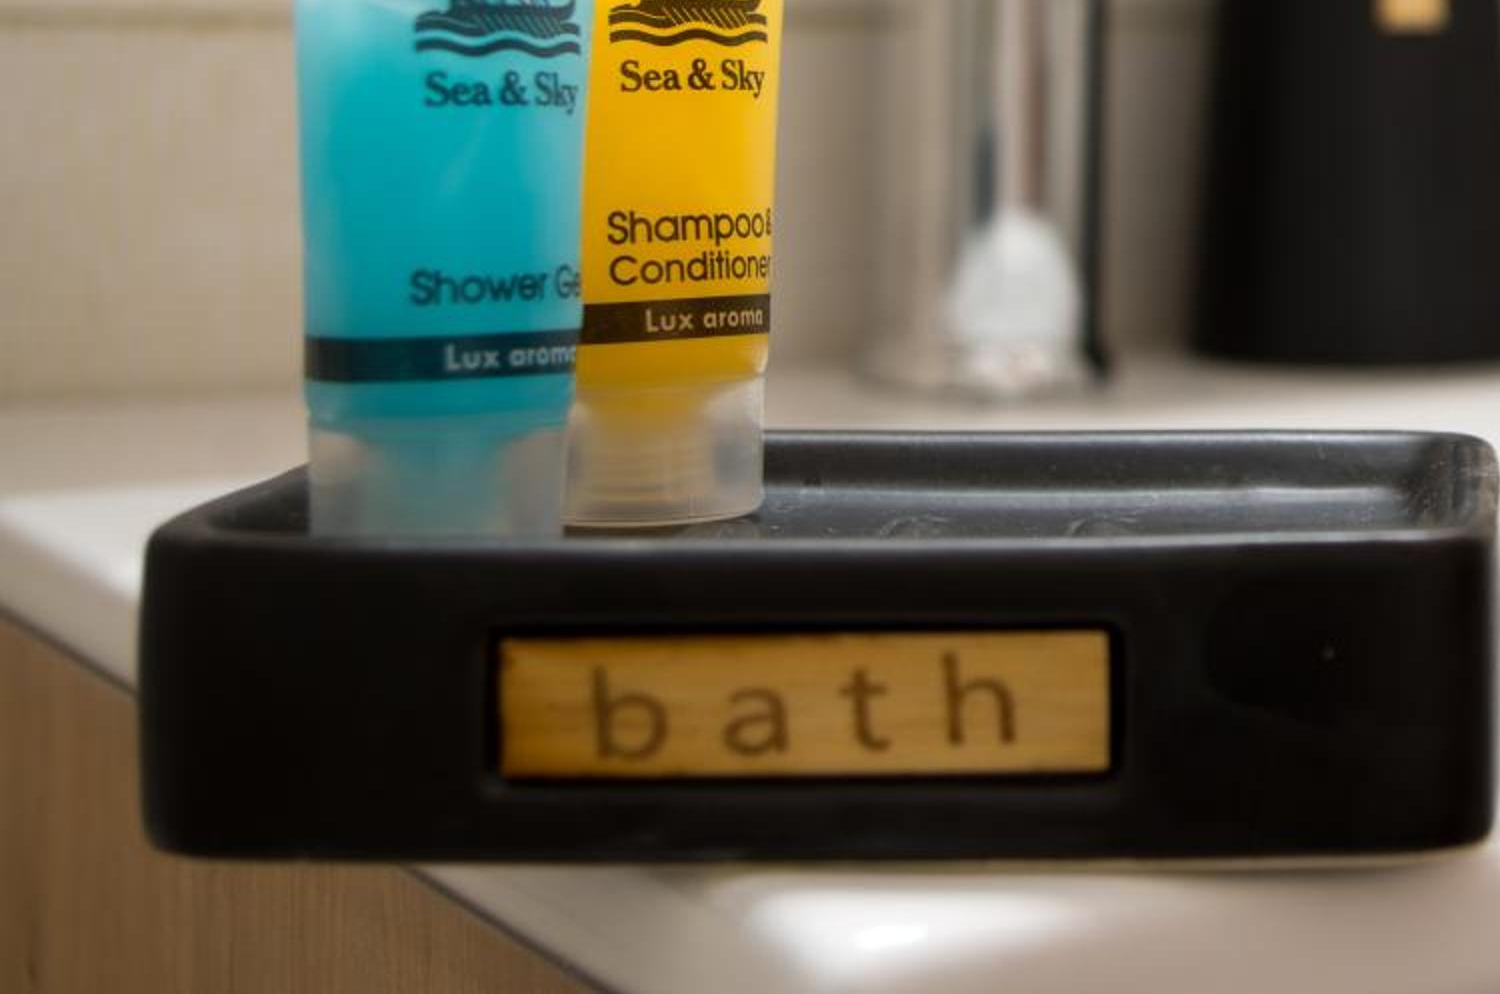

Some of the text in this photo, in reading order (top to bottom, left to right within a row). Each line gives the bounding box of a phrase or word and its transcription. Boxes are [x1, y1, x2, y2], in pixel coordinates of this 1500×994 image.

[424, 71, 578, 115] Sea & Sky
[620, 58, 765, 98] Sea & Sky
[410, 268, 548, 306] Shower
[645, 309, 763, 333] Lux aroma
[445, 344, 500, 372] Lux
[591, 651, 1016, 762] bath
